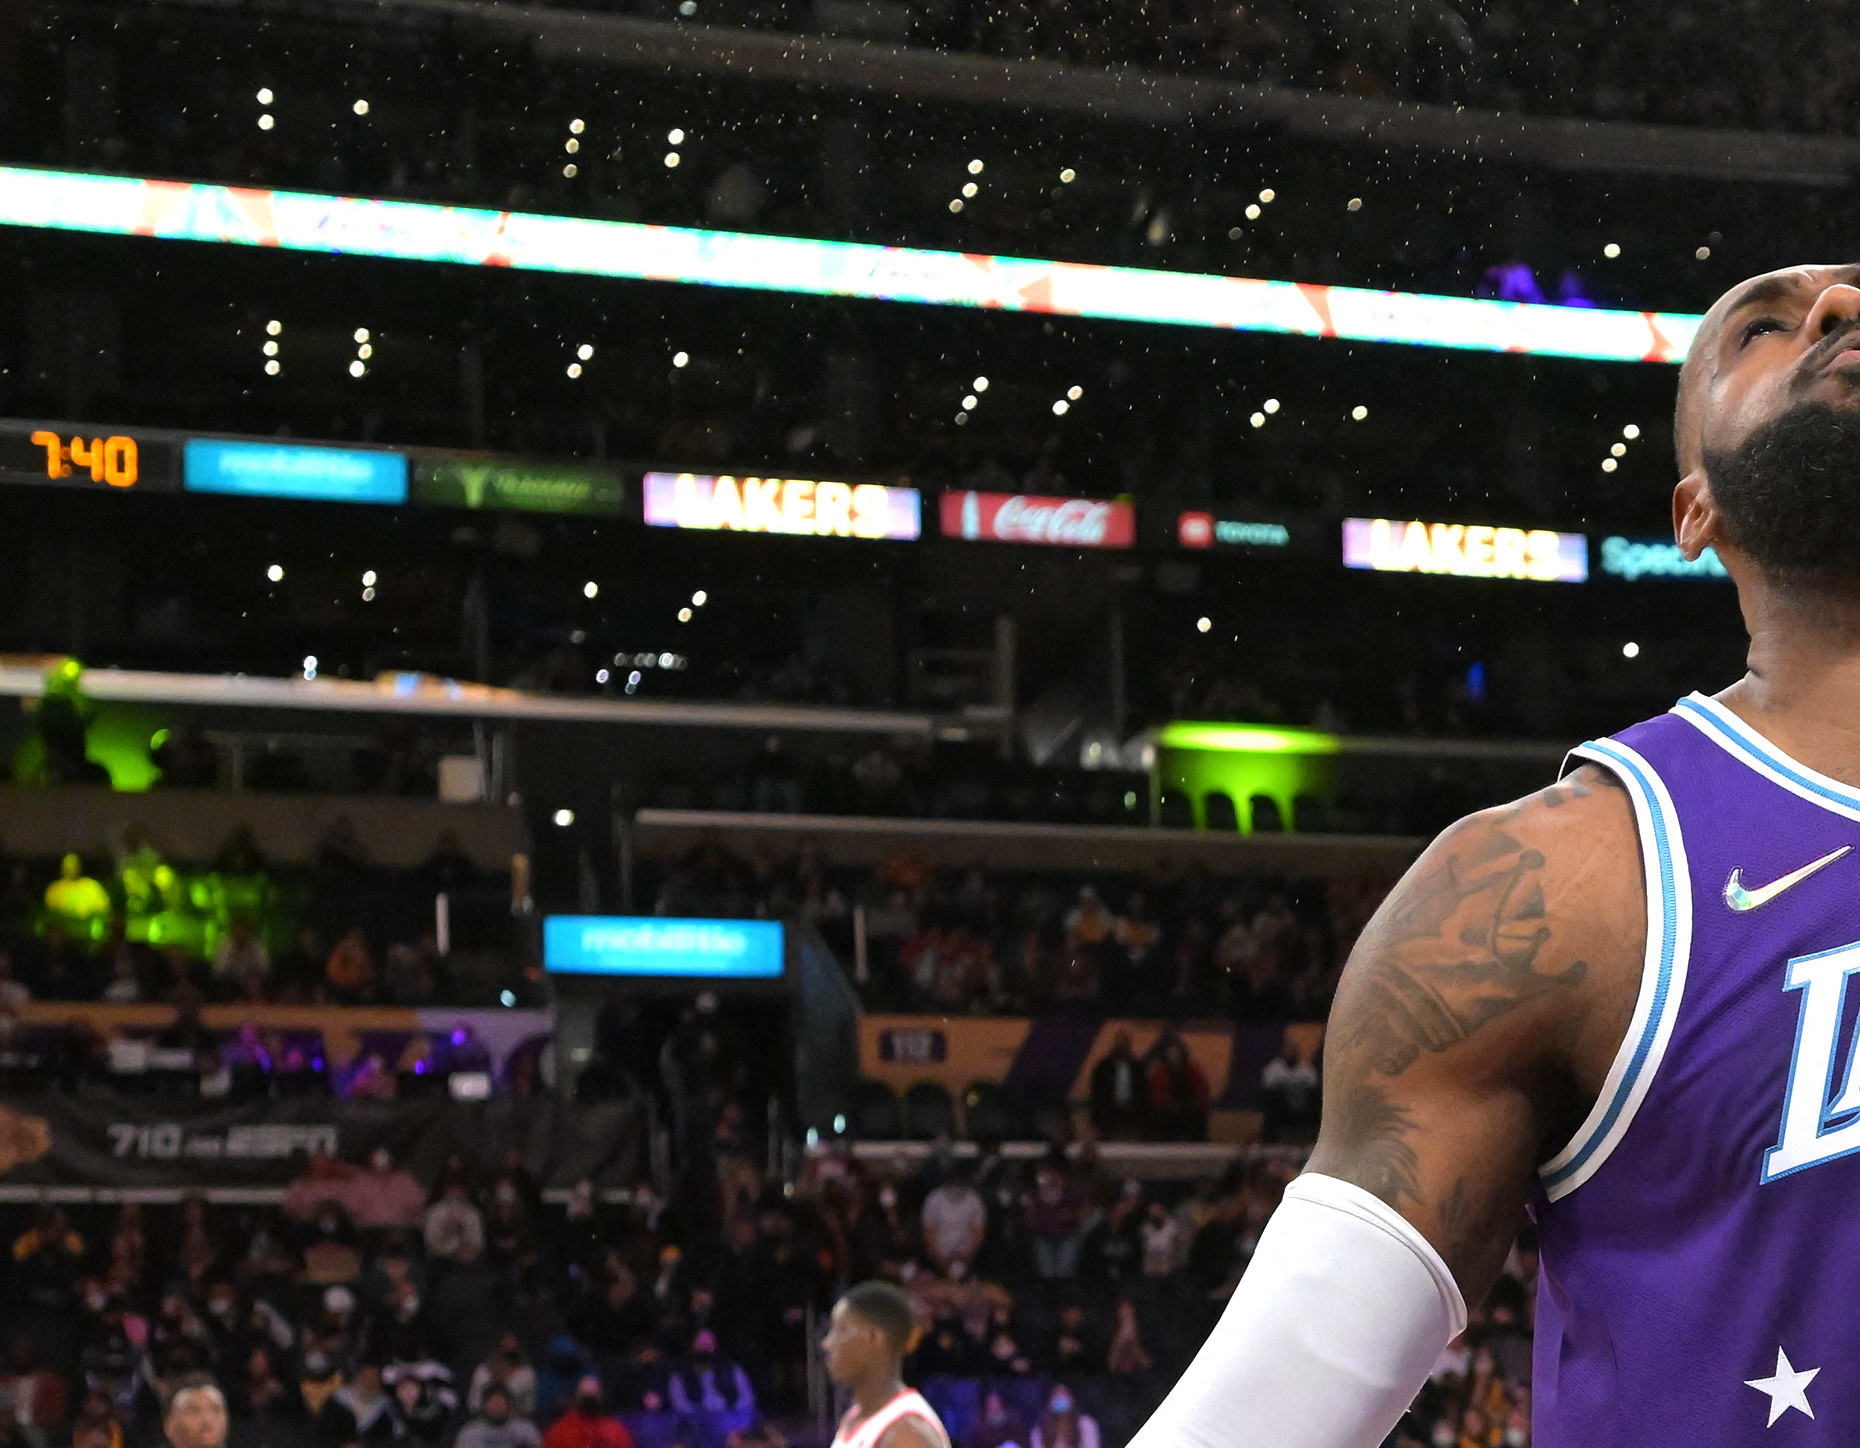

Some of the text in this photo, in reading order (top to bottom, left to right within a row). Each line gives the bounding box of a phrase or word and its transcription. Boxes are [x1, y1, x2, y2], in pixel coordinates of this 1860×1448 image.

[30, 430, 138, 488] 7:40
[672, 472, 892, 538] LAKERS
[1370, 517, 1563, 583] LAKERS
[106, 1122, 183, 1160] 710
